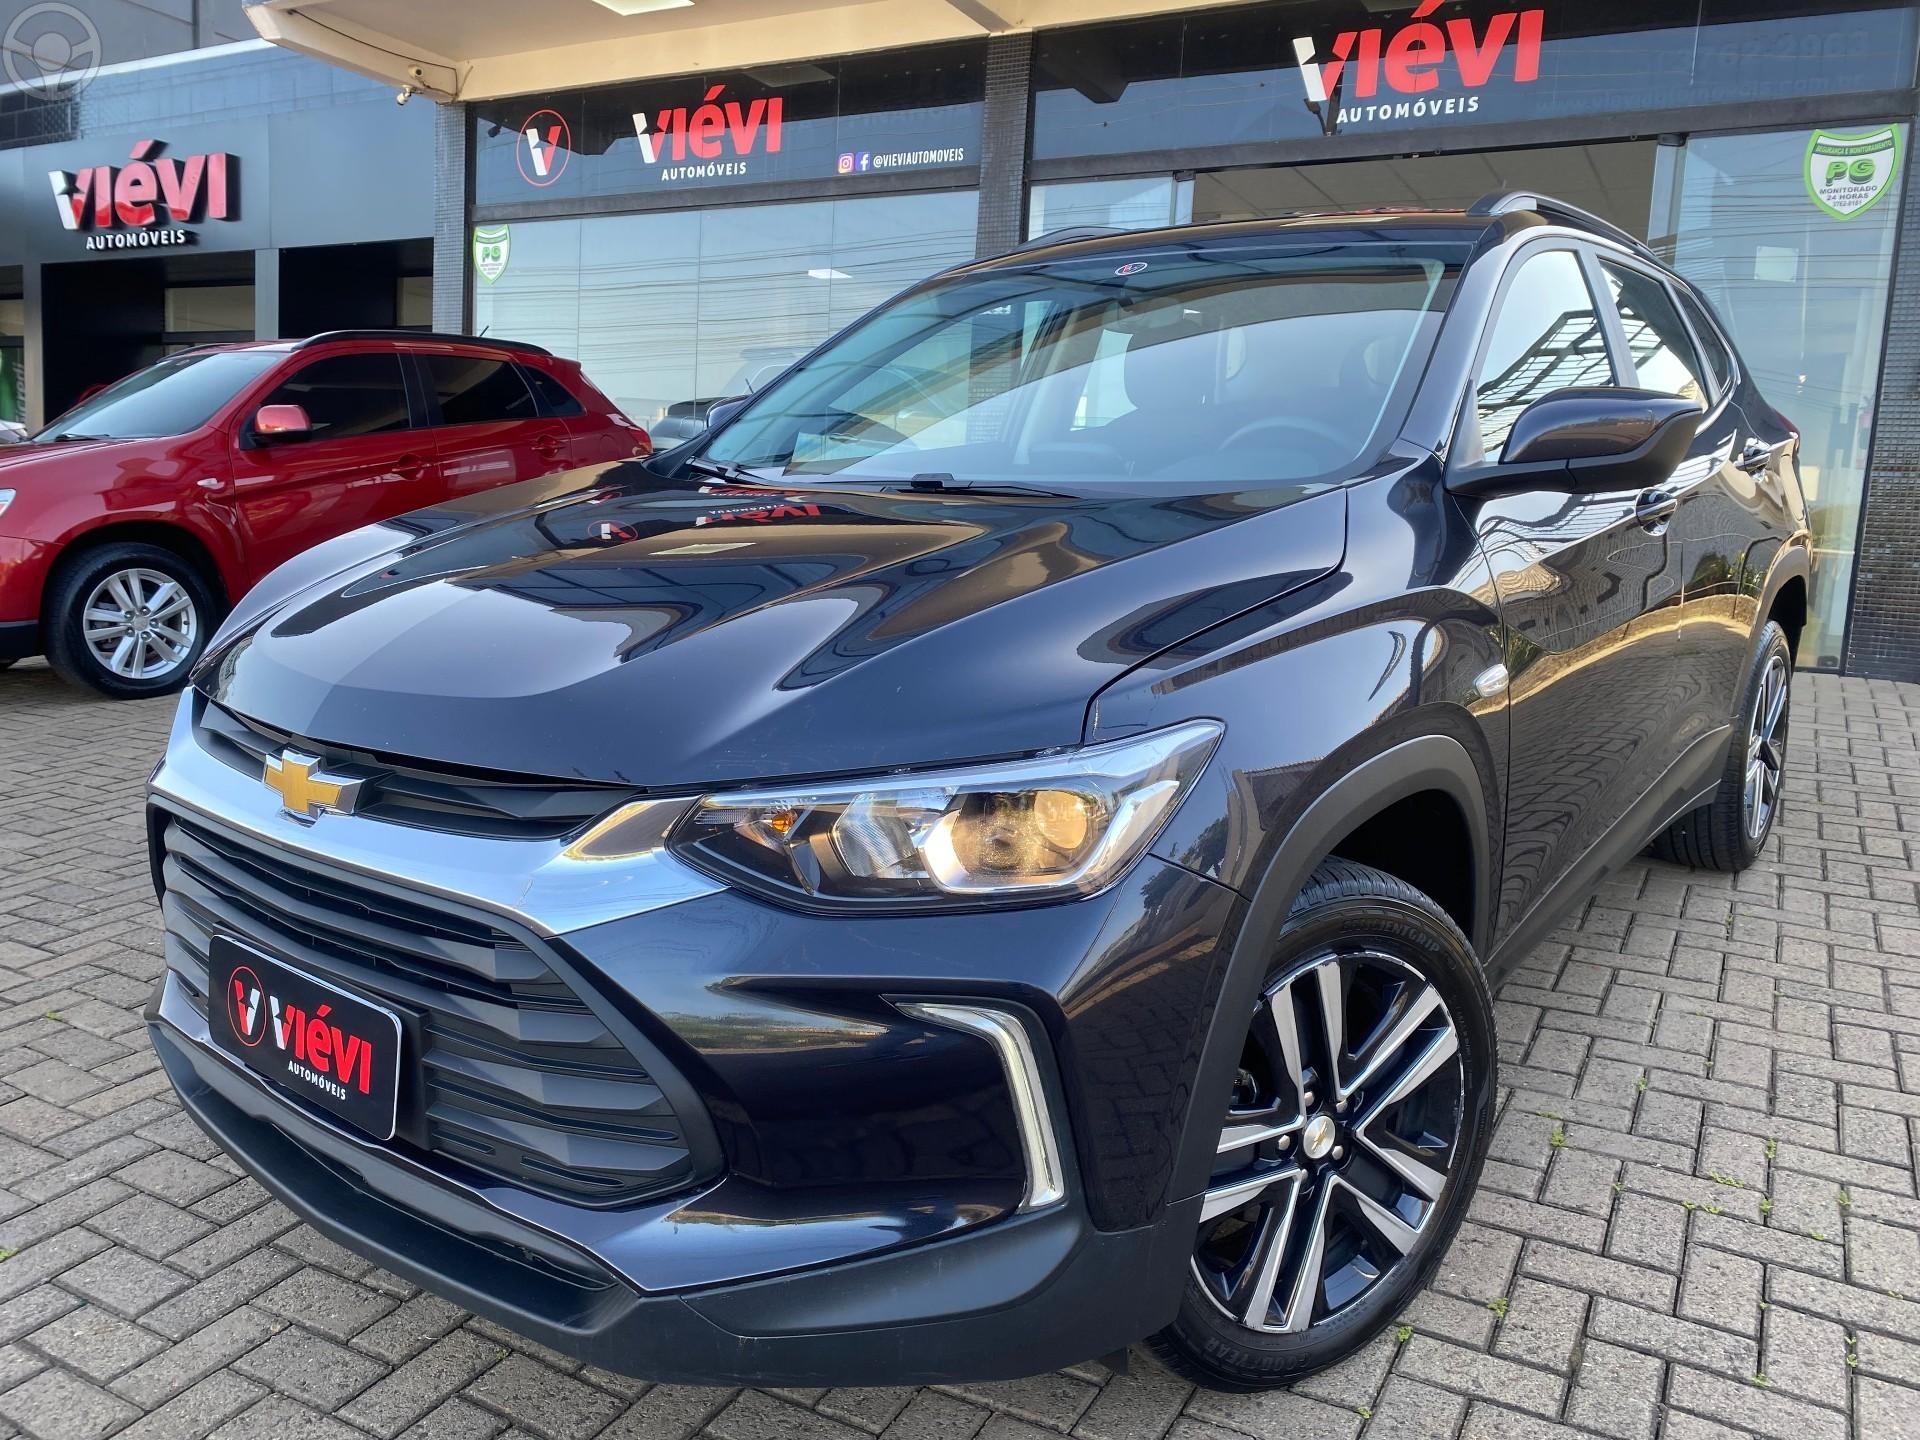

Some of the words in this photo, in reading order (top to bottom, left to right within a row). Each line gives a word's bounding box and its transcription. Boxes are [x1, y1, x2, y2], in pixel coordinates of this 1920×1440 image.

[1336, 96, 1480, 126] AUTOMÓVEIS
[872, 147, 965, 168] @VIEVIAUTOMOVEIS
[660, 161, 749, 182] AUTOMÓVEIS
[1826, 159, 1875, 186] PG
[1819, 186, 1879, 196] MONITORADO
[1827, 194, 1838, 202] 24
[1839, 192, 1870, 201] HORAS
[85, 227, 187, 250] AUTOMÓVEIS
[287, 1060, 346, 1100] AUTOMÓVEIS
